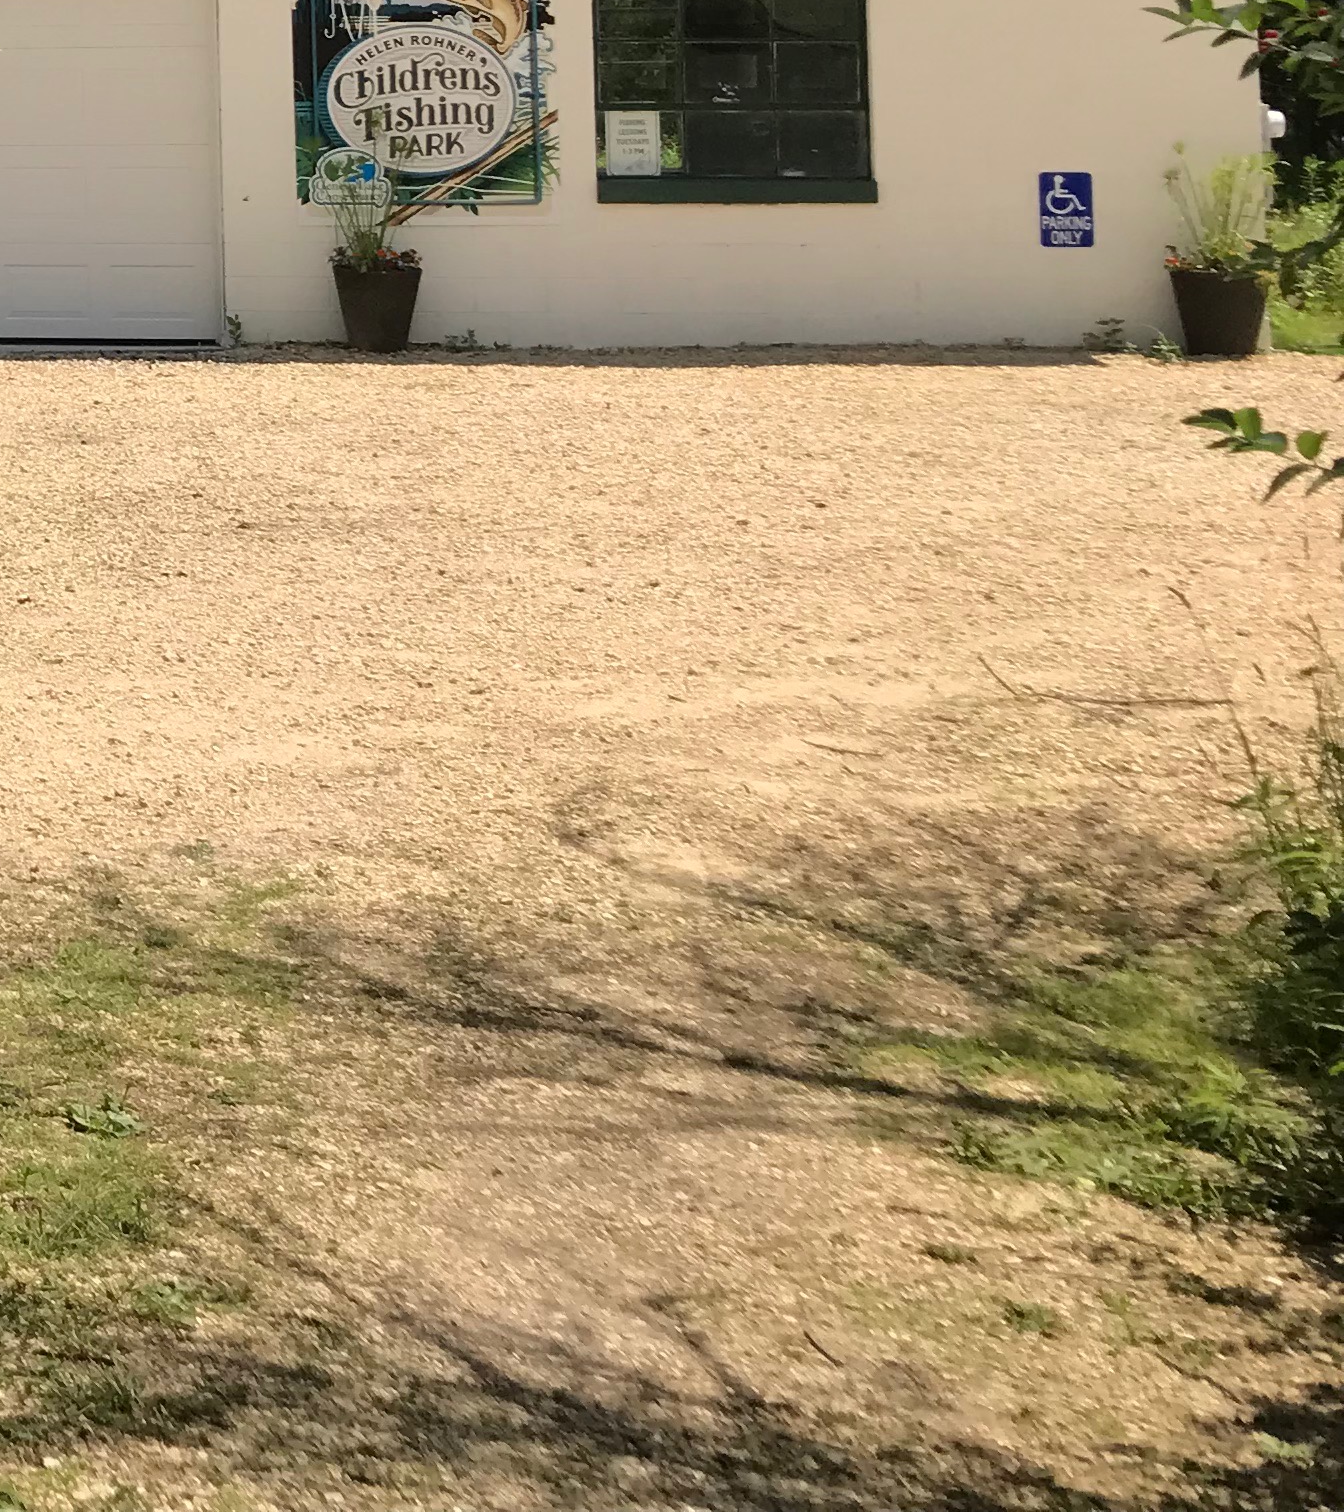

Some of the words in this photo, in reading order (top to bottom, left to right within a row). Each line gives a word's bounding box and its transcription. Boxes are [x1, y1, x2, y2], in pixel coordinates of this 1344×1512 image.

[355, 37, 404, 66] HELEN
[410, 35, 477, 63] ROHNER
[334, 52, 501, 109] Children's
[353, 95, 495, 143] Fishing
[389, 131, 465, 160] PARK
[1041, 215, 1092, 230] PARKING
[1051, 230, 1083, 245] ONLY
